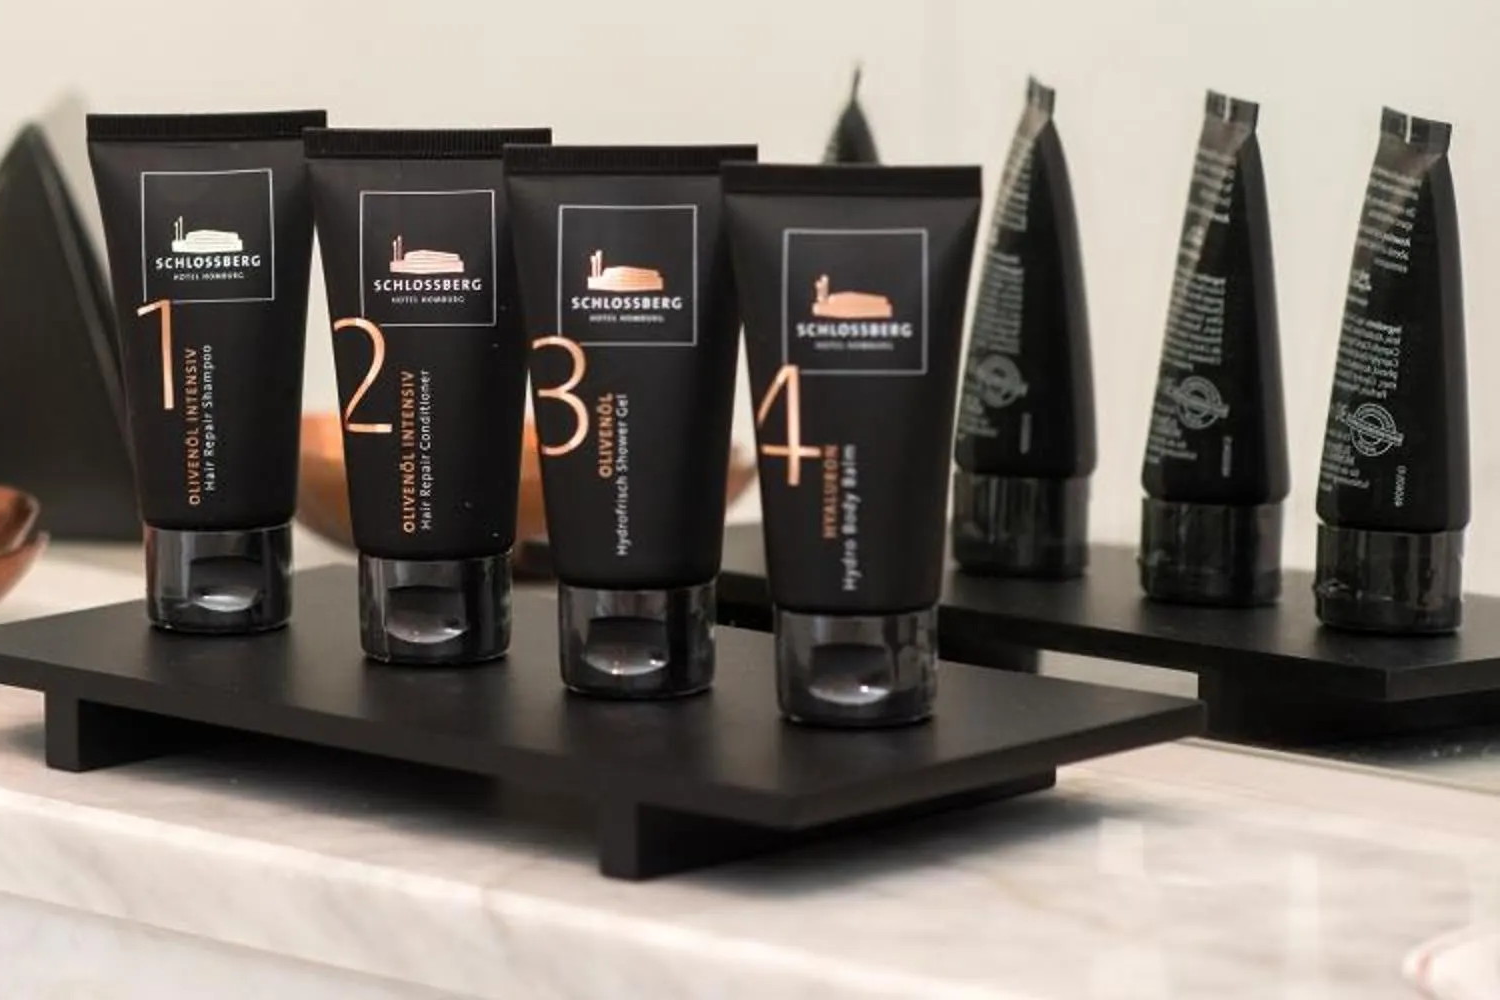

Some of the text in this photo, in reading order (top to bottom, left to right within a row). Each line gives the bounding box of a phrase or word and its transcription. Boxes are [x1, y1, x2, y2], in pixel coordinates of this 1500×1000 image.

[155, 255, 261, 270] SCHLOSSBERG
[373, 278, 482, 292] SCHLOSSBERG
[571, 296, 683, 310] SCHLOSSBERG
[137, 300, 174, 410] 1
[333, 317, 393, 434] 2
[796, 322, 913, 337] SCHLOSSBERG
[185, 348, 200, 505] OLIVENÖL INTENSIV
[202, 344, 216, 491] Hair Repair Shampoo
[400, 370, 416, 533] OLIVENÖL INTENSIV
[419, 369, 434, 530] Hair Repair Conditioner
[532, 335, 589, 456] 3
[596, 392, 613, 478] OLIVENÖL
[757, 364, 821, 486] 4
[615, 394, 632, 556] Hydrofrisch Shower Gel
[841, 444, 862, 591] Hydro Body Balm
